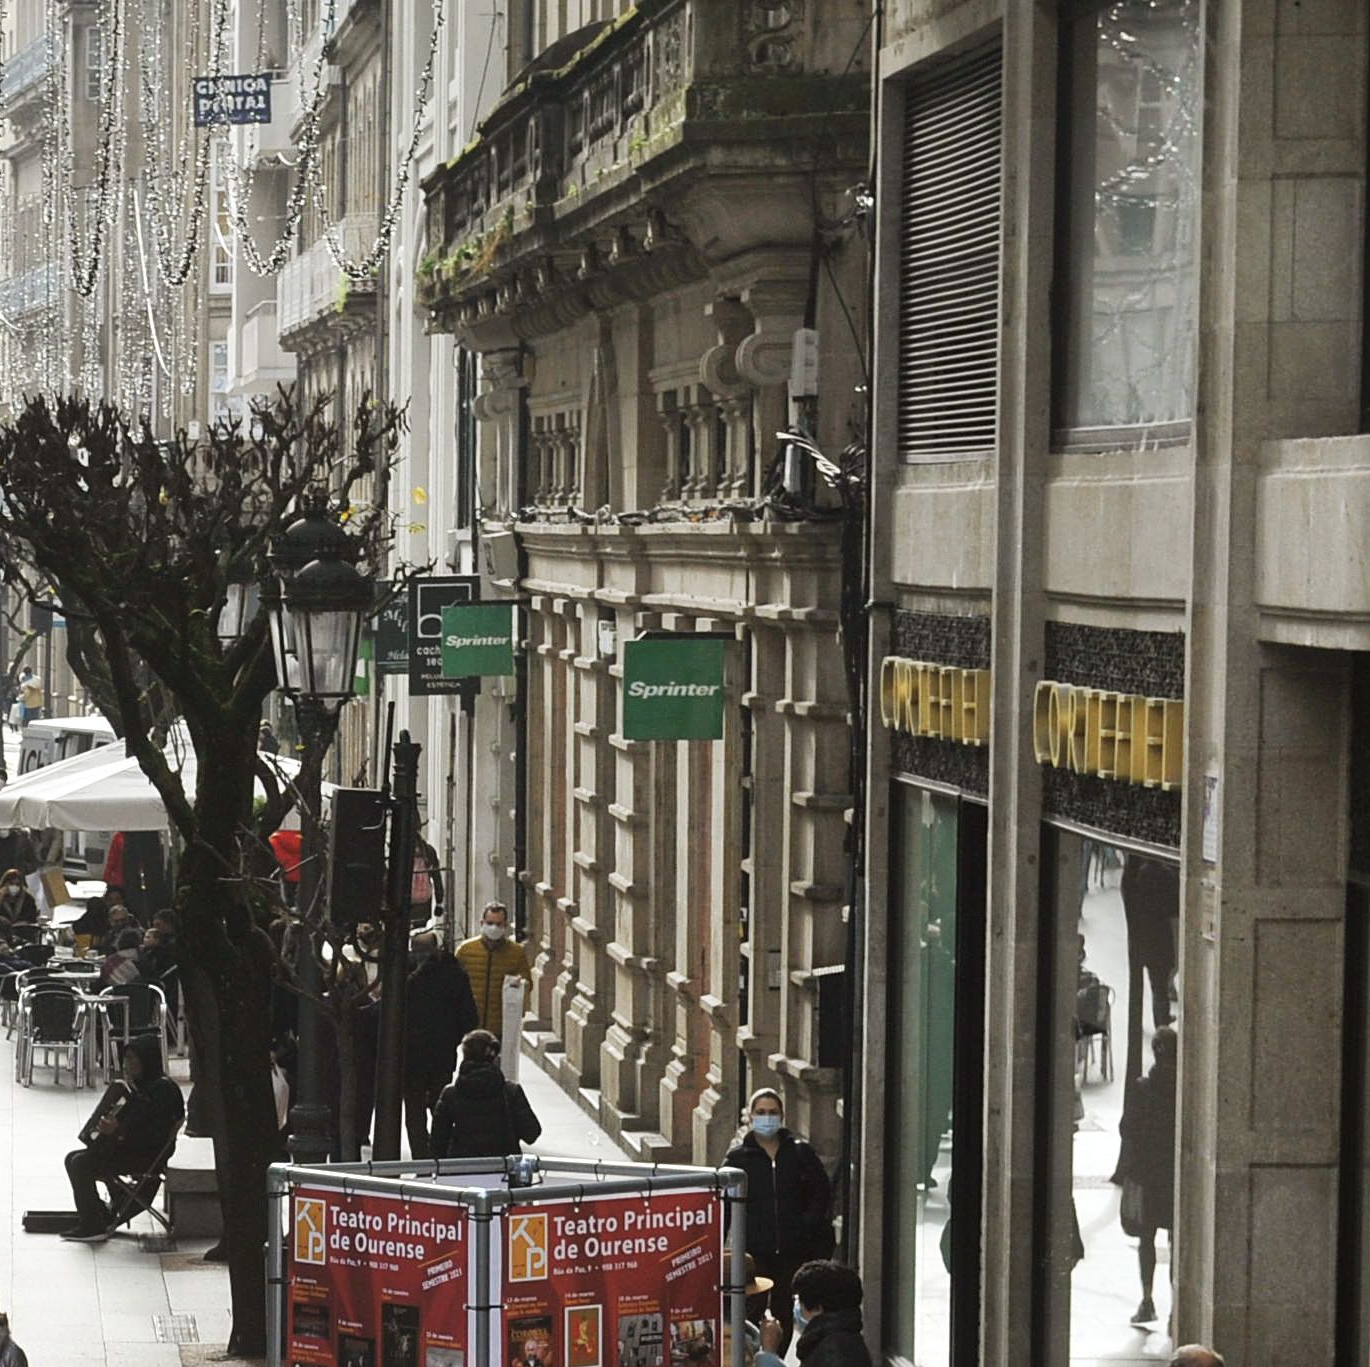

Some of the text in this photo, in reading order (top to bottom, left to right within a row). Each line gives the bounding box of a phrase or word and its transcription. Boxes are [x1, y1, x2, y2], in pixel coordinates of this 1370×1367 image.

[445, 634, 509, 651] Sprinter
[628, 681, 719, 699] Sprinter
[330, 1206, 462, 1244] Teatro Principal
[554, 1204, 713, 1236] Teatro Principal
[330, 1229, 425, 1260] de Ourense
[554, 1236, 668, 1260] de Ourense
[671, 1246, 702, 1267] PRIMEIRO
[698, 1252, 713, 1266] 2021
[449, 1267, 463, 1281] 2021
